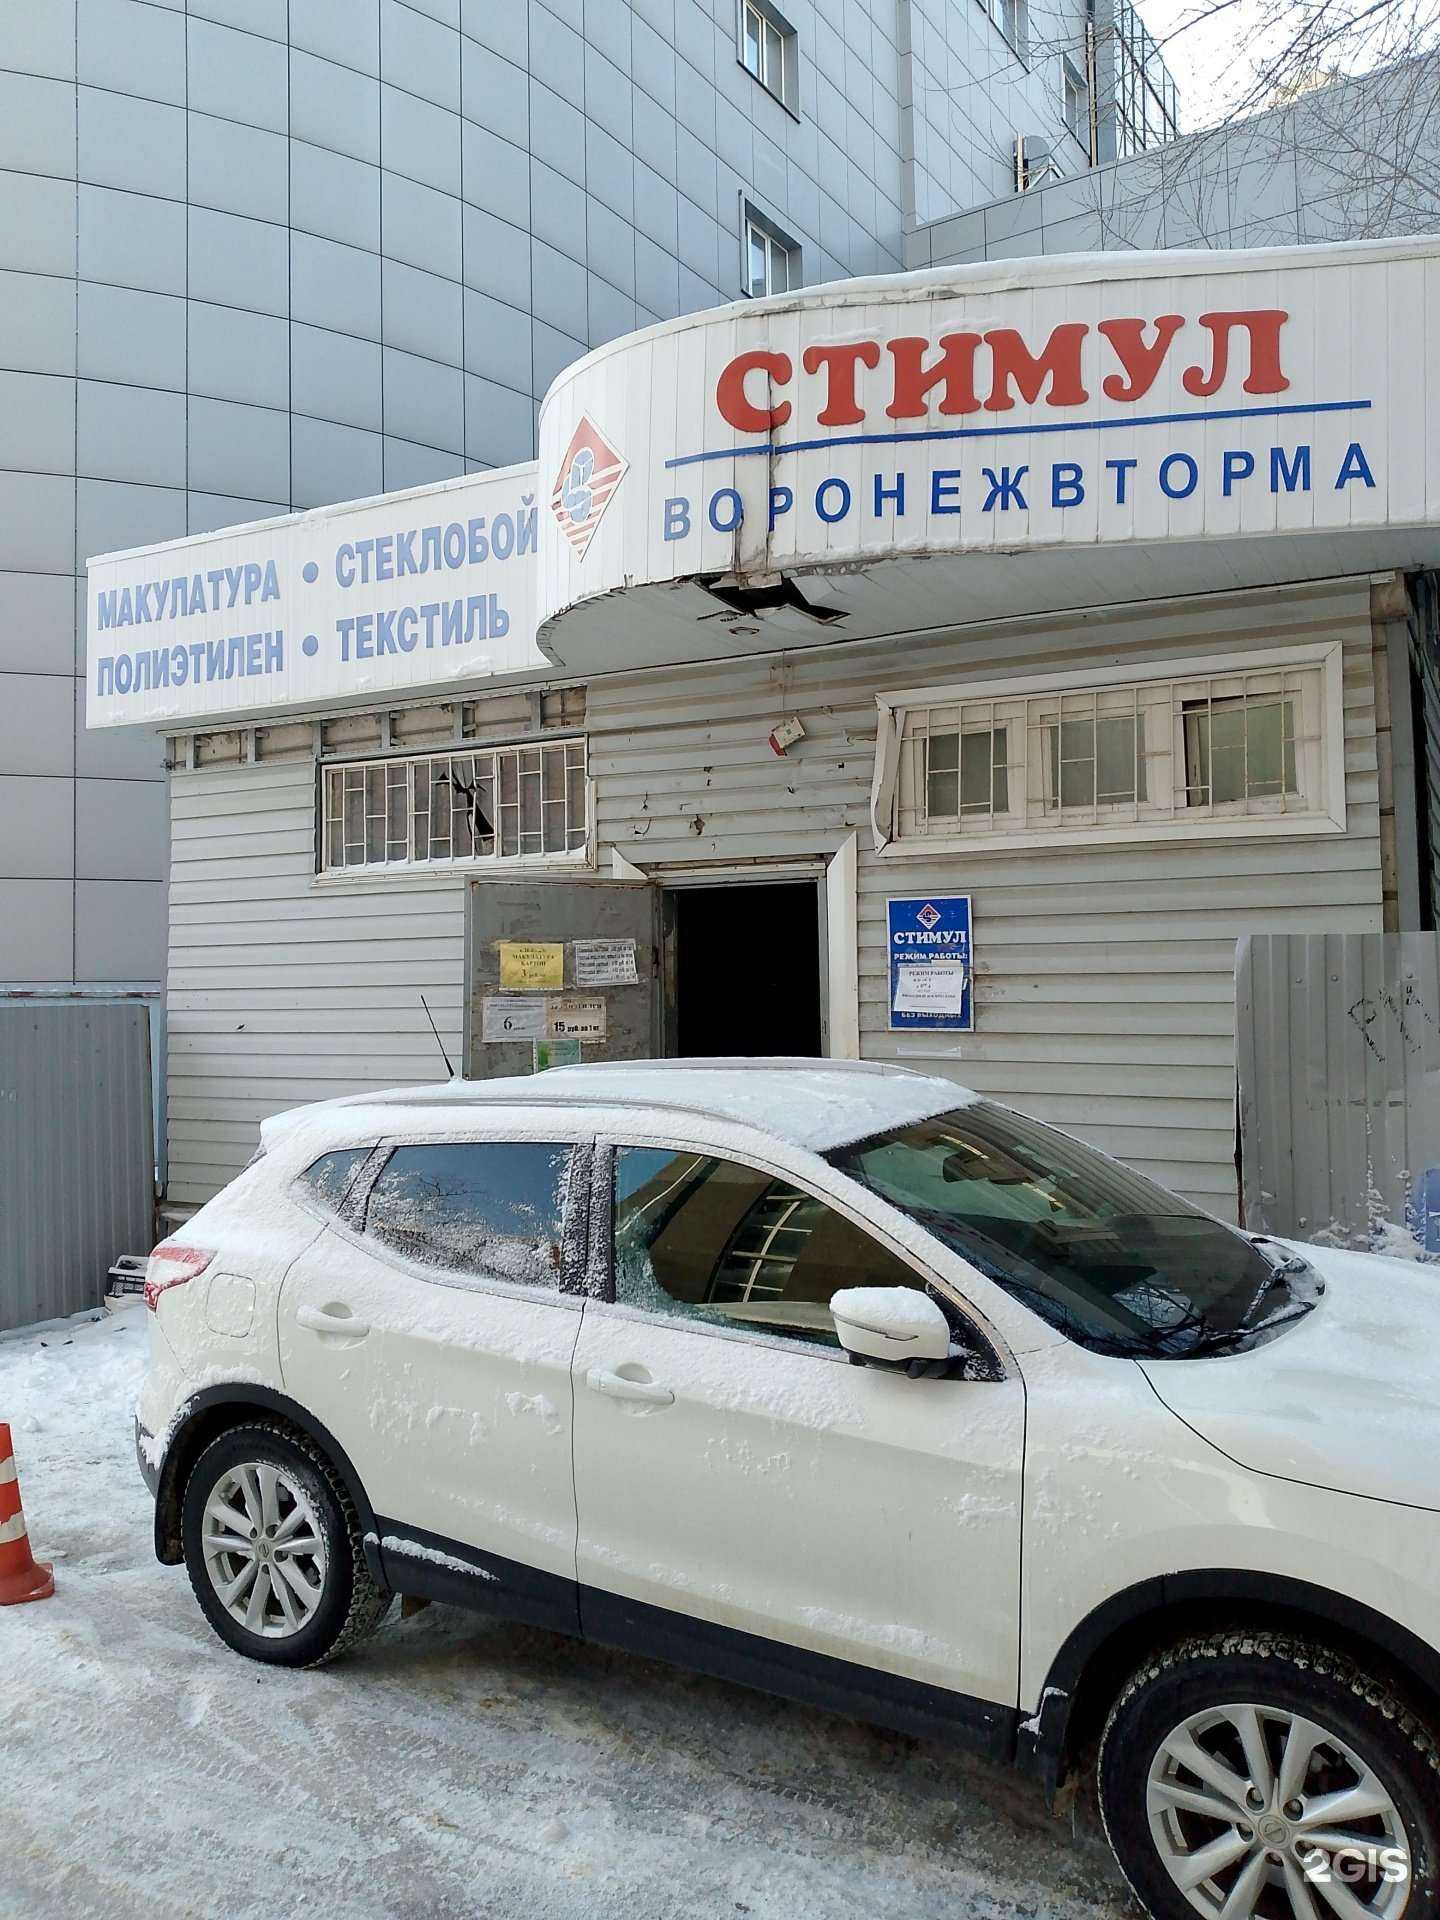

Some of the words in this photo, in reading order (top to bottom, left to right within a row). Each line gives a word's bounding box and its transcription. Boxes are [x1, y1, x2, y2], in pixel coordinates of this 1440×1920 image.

[716, 309, 1290, 433] СТИМУЛ
[664, 442, 1376, 542] ВОРОНЕЖВТОРМА
[97, 560, 280, 631] МАКУЛАТУРА
[335, 494, 538, 588] СТЕКЛОБОЙ
[97, 630, 284, 696] ПОЛИЭТИЛЕН
[336, 593, 510, 662] ТЕКСТИЛЬ
[893, 931, 967, 944] СТИМУЛ
[503, 1016, 513, 1031] 6
[553, 1021, 566, 1032] 15
